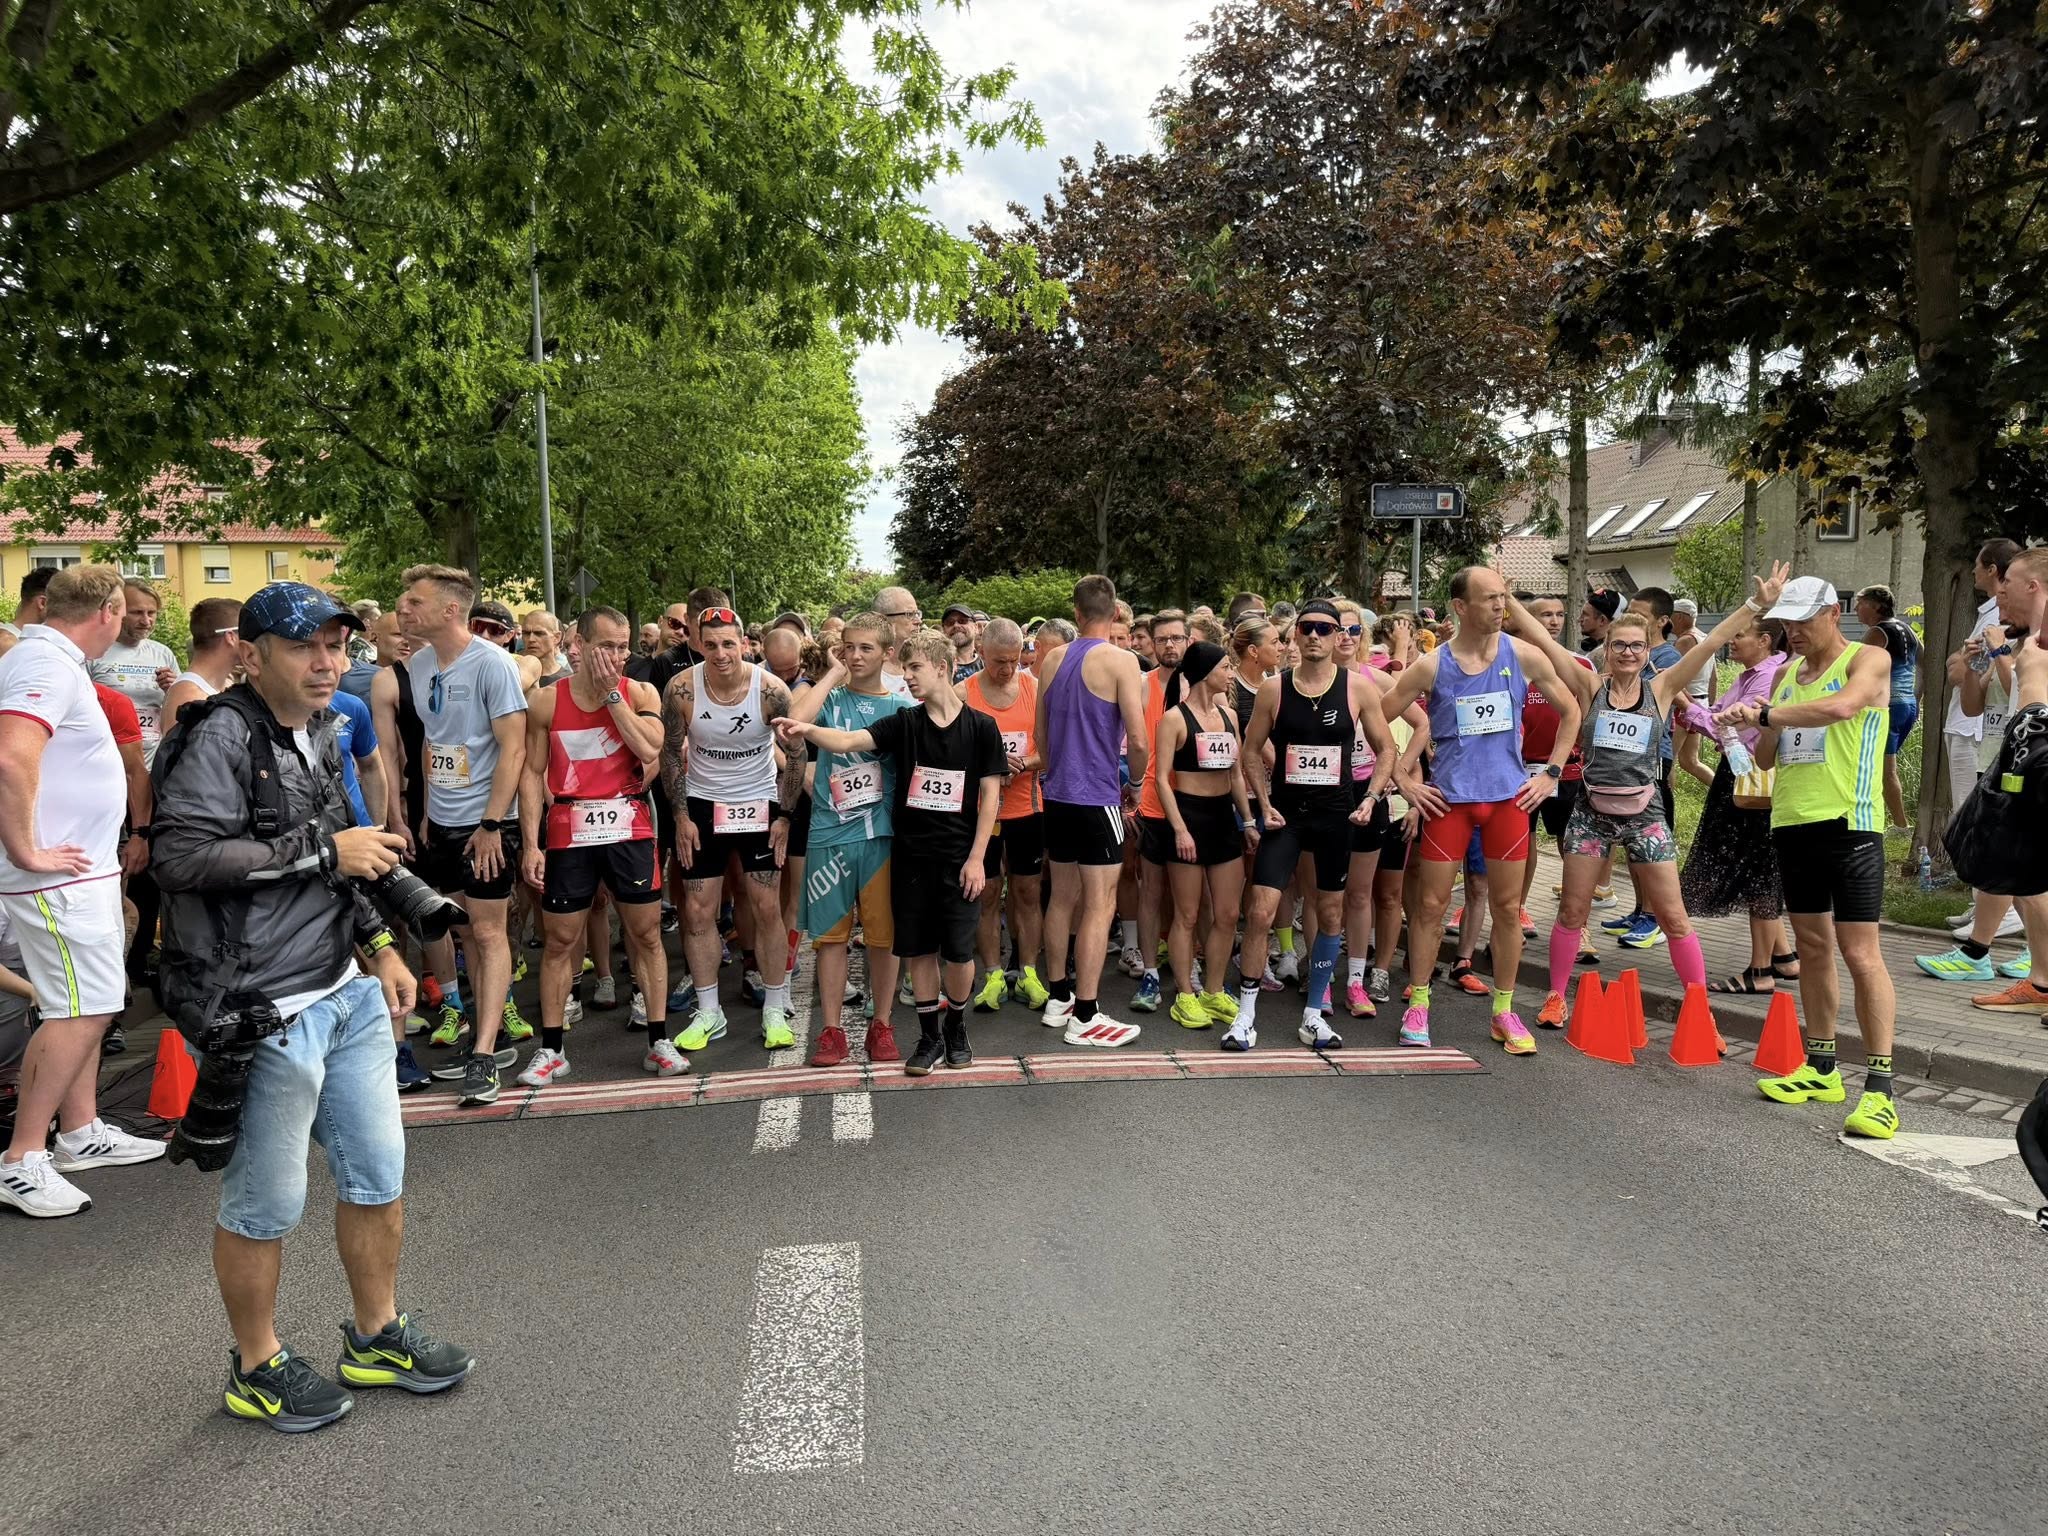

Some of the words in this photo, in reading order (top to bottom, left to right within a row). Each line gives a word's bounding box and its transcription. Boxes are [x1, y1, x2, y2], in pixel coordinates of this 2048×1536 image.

[1475, 704, 1495, 719] 99
[1986, 713, 2003, 725] 167
[1608, 721, 1637, 737] 100
[1794, 732, 1802, 746] 8
[1209, 742, 1230, 754] 441
[431, 755, 454, 770] 278
[1298, 756, 1328, 769] 344
[842, 774, 873, 793] 362
[921, 780, 952, 796] 433
[585, 811, 618, 825] 419
[727, 807, 756, 819] 332
